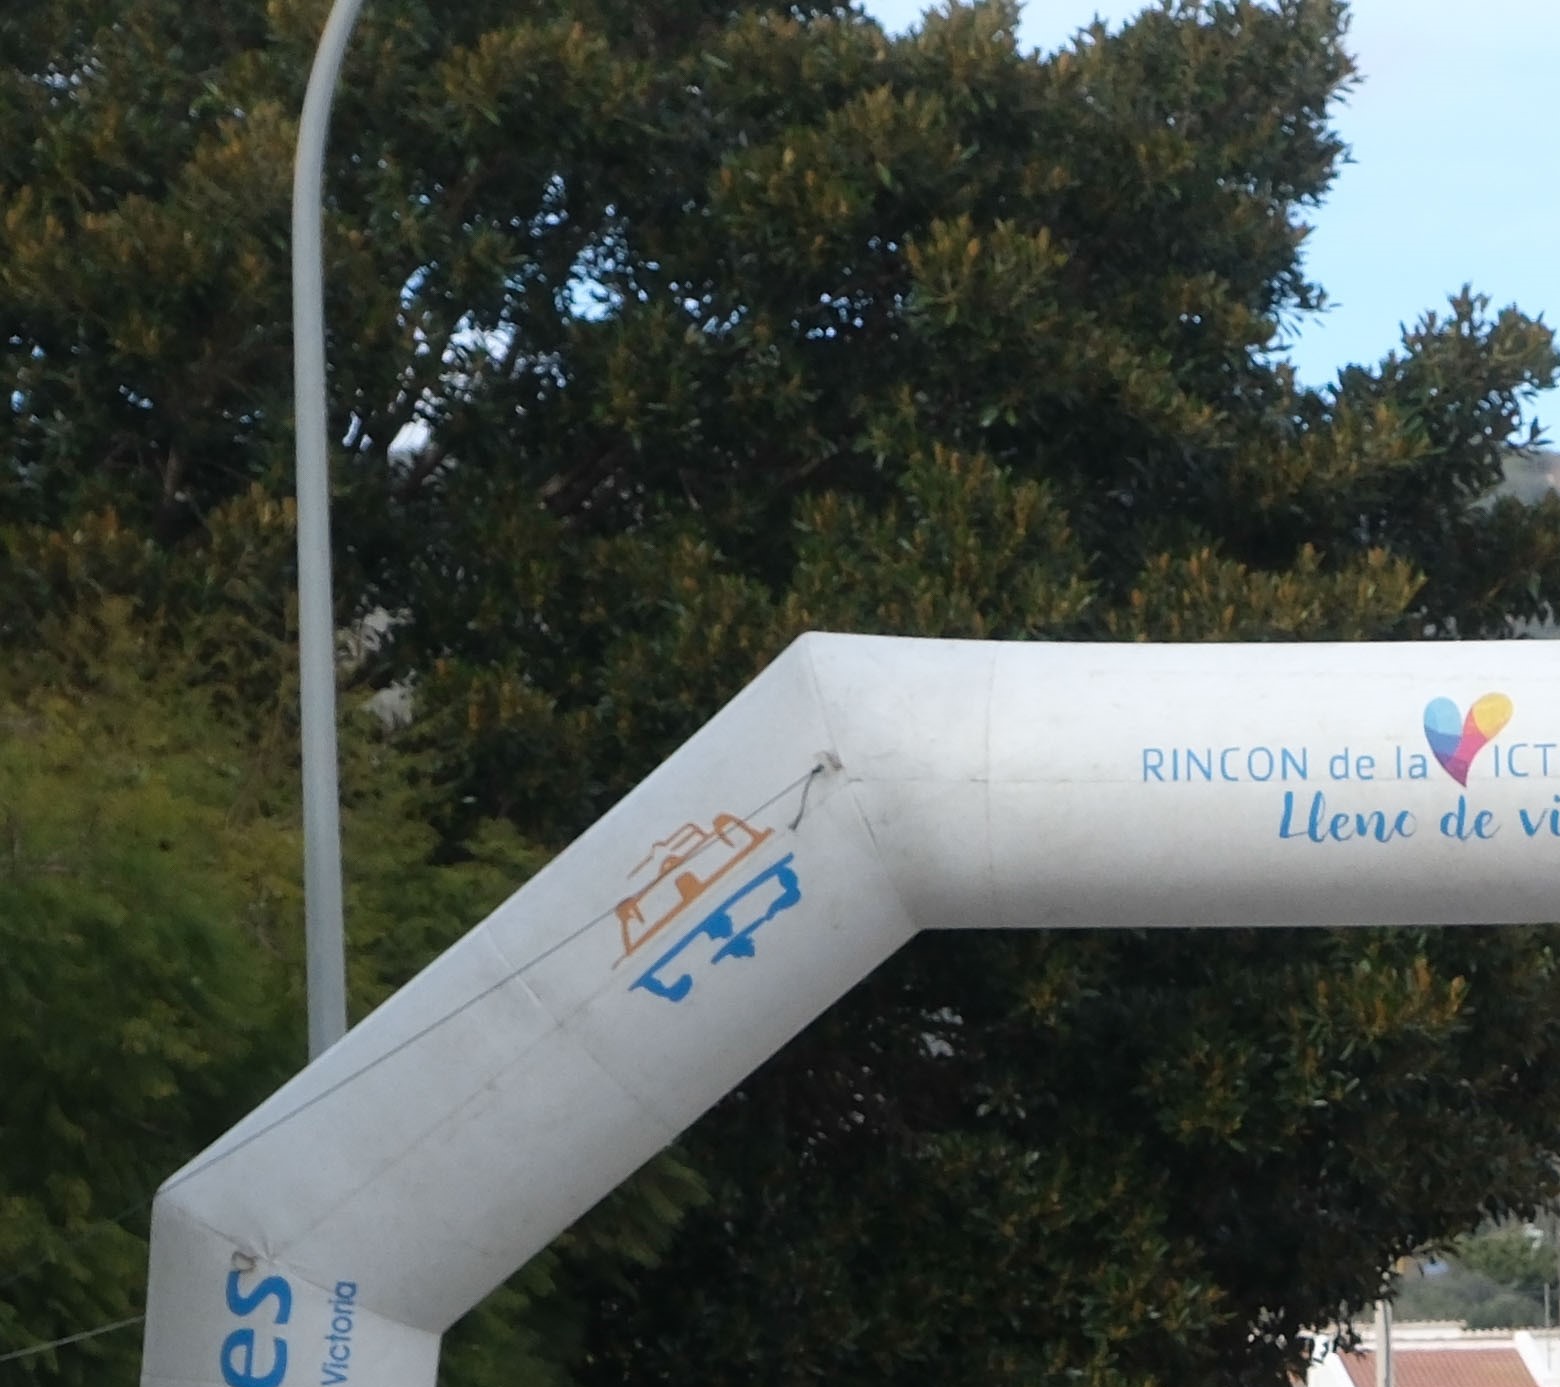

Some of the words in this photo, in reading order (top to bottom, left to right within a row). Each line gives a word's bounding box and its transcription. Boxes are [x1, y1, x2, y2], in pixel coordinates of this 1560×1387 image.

[1142, 747, 1309, 782] RINCON
[1329, 747, 1376, 780] de
[1396, 746, 1429, 780] la
[1440, 795, 1500, 840] de
[322, 1280, 357, 1387] Victoria
